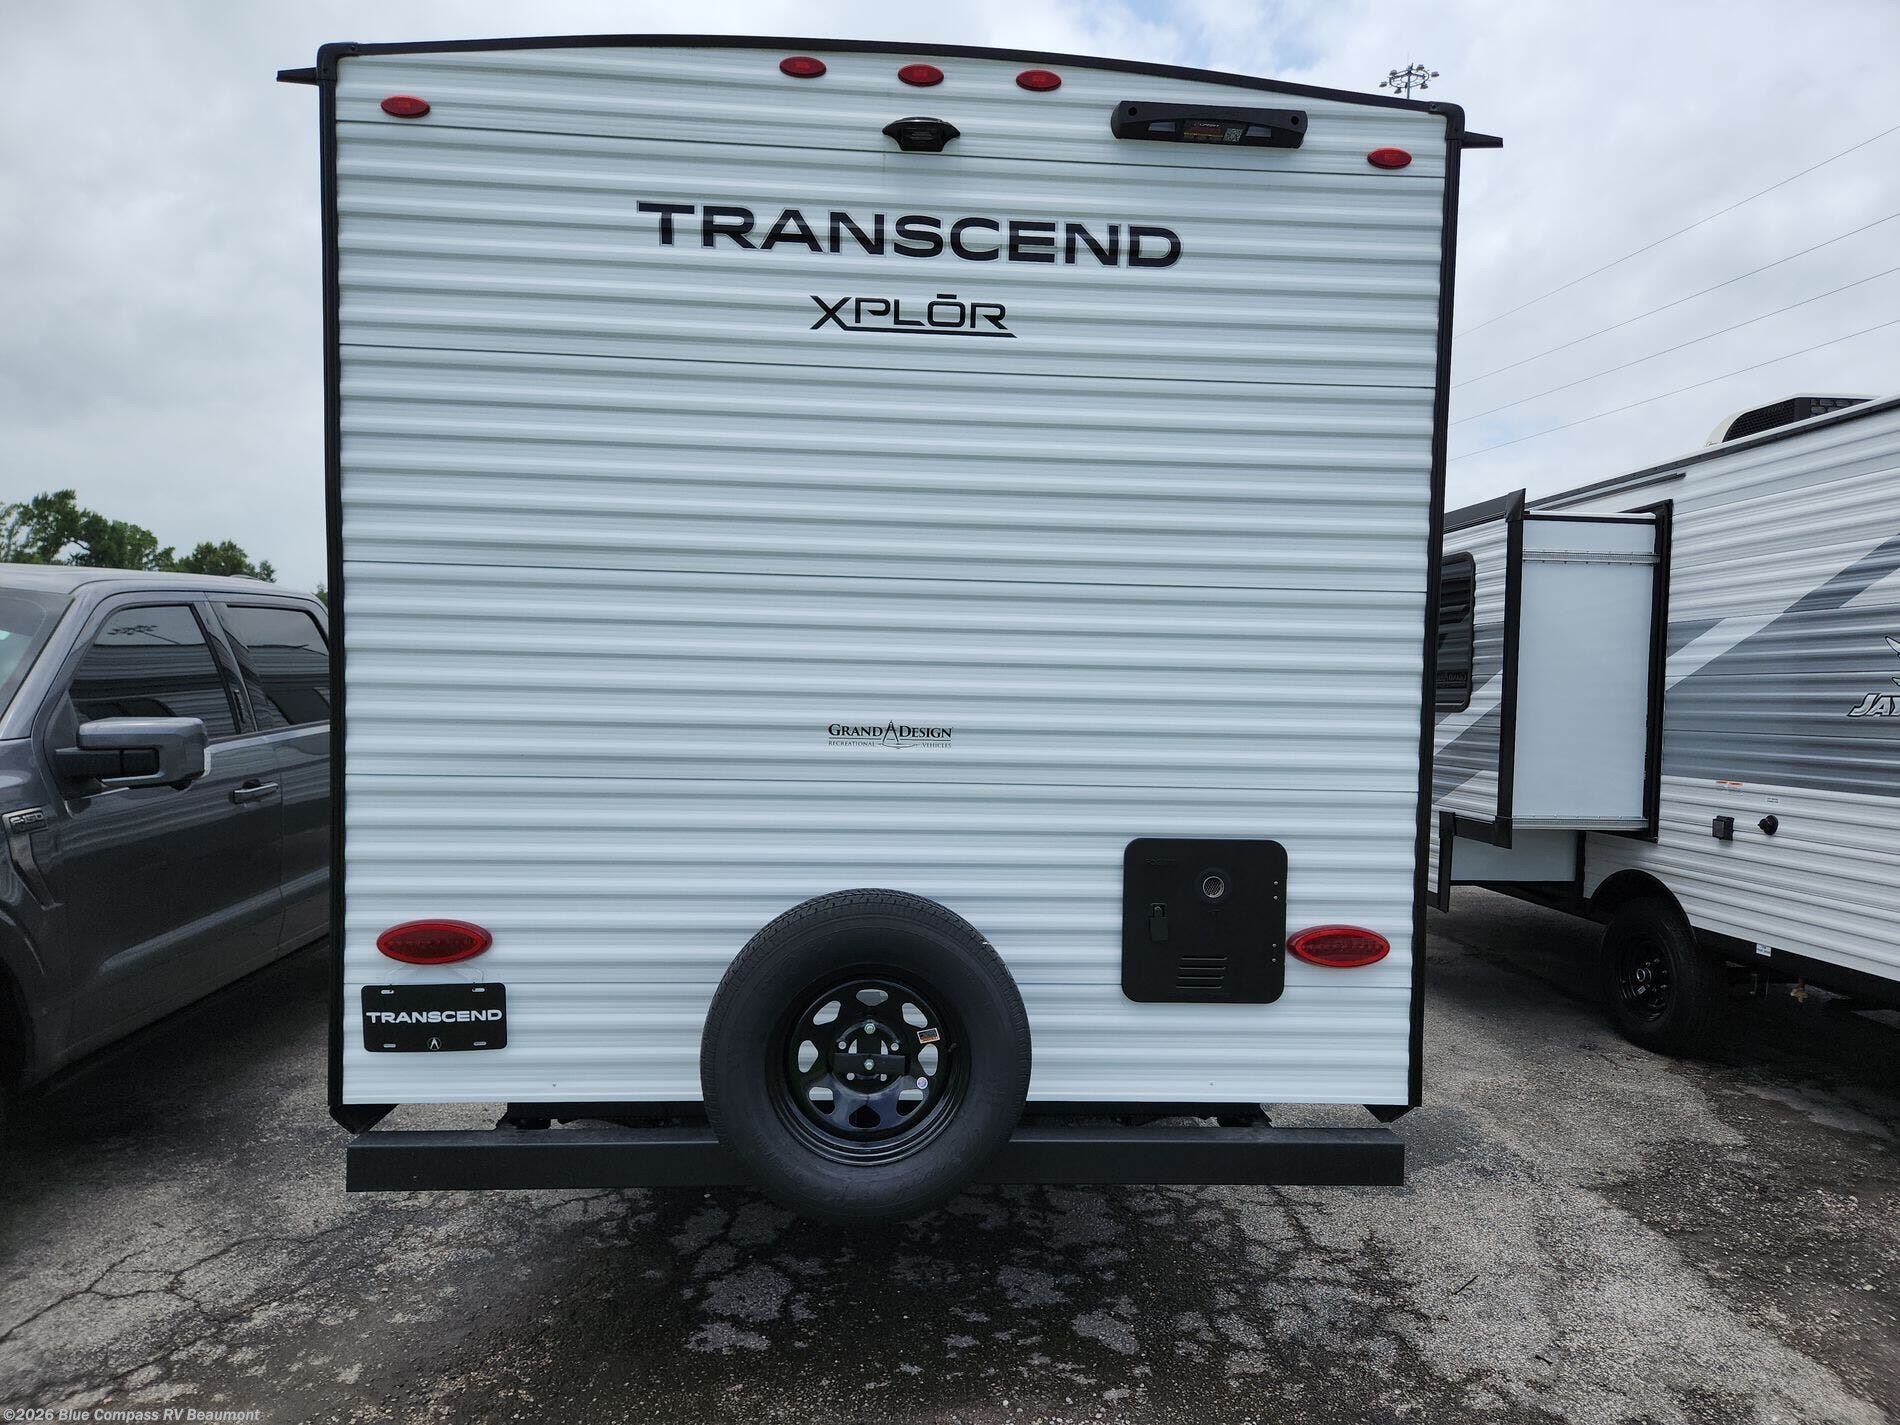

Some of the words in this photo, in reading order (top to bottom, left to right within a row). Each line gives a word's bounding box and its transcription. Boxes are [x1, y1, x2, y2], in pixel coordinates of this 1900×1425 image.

[636, 200, 1183, 268] TRANSCEND
[828, 723, 883, 737] GRAND
[899, 725, 952, 738] DESIGN
[366, 1009, 502, 1024] TRANSCEND
